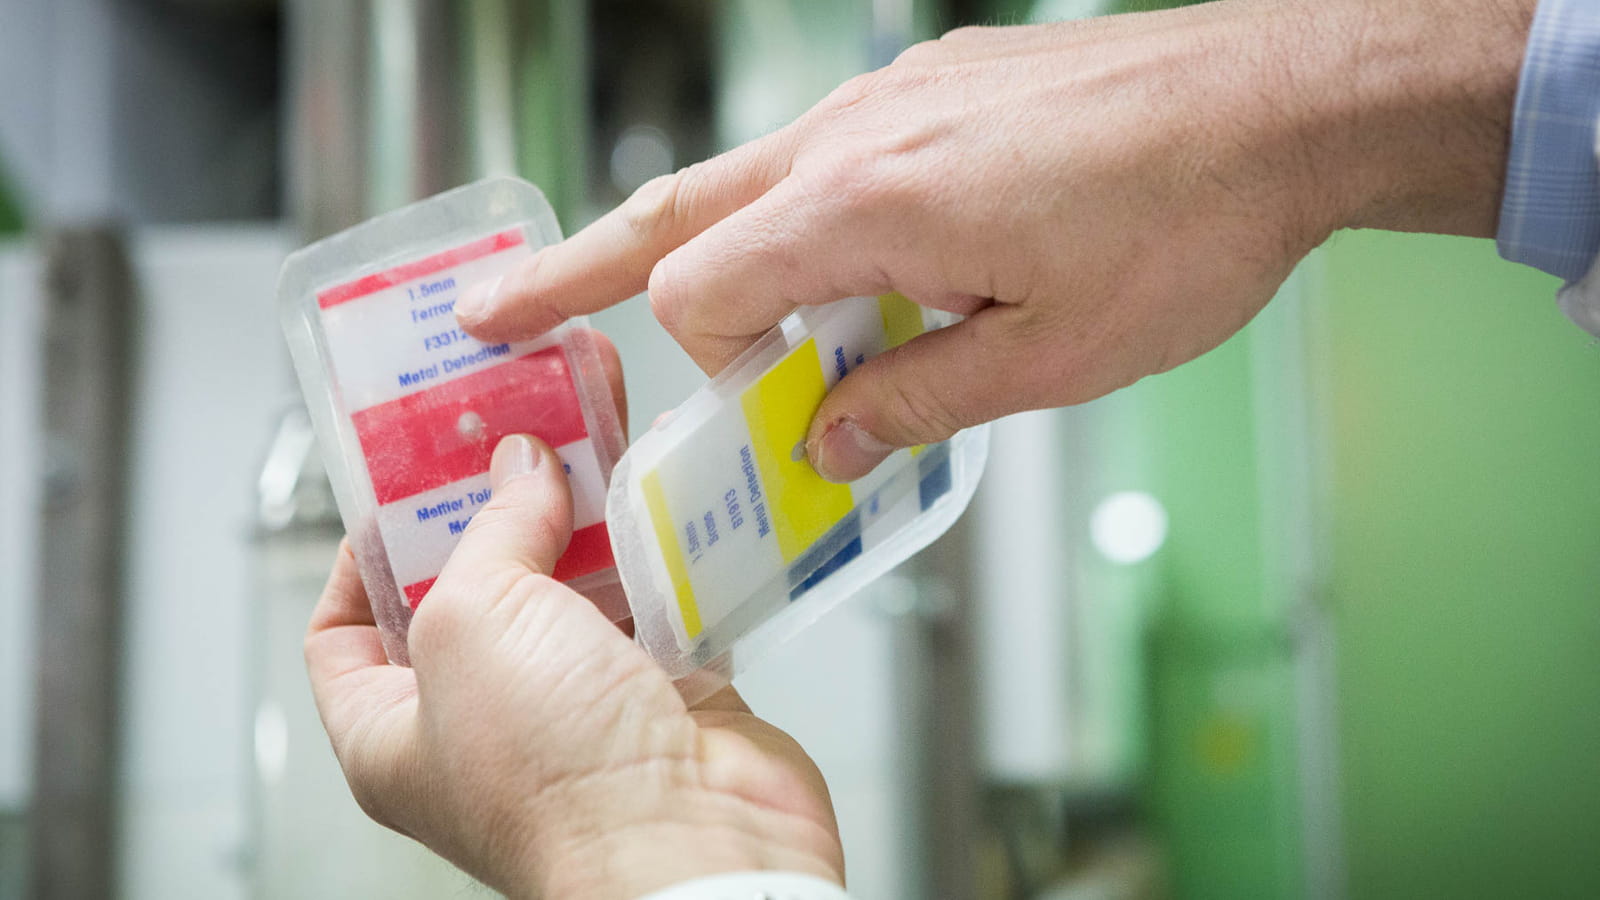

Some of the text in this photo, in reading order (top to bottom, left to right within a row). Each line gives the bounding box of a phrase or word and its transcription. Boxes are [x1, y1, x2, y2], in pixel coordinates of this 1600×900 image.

[408, 278, 456, 301] 1.5mm
[398, 343, 511, 387] Metal Detection
[724, 488, 744, 530] B1913
[740, 444, 770, 538] Metal Detection
[704, 510, 719, 547] Brass
